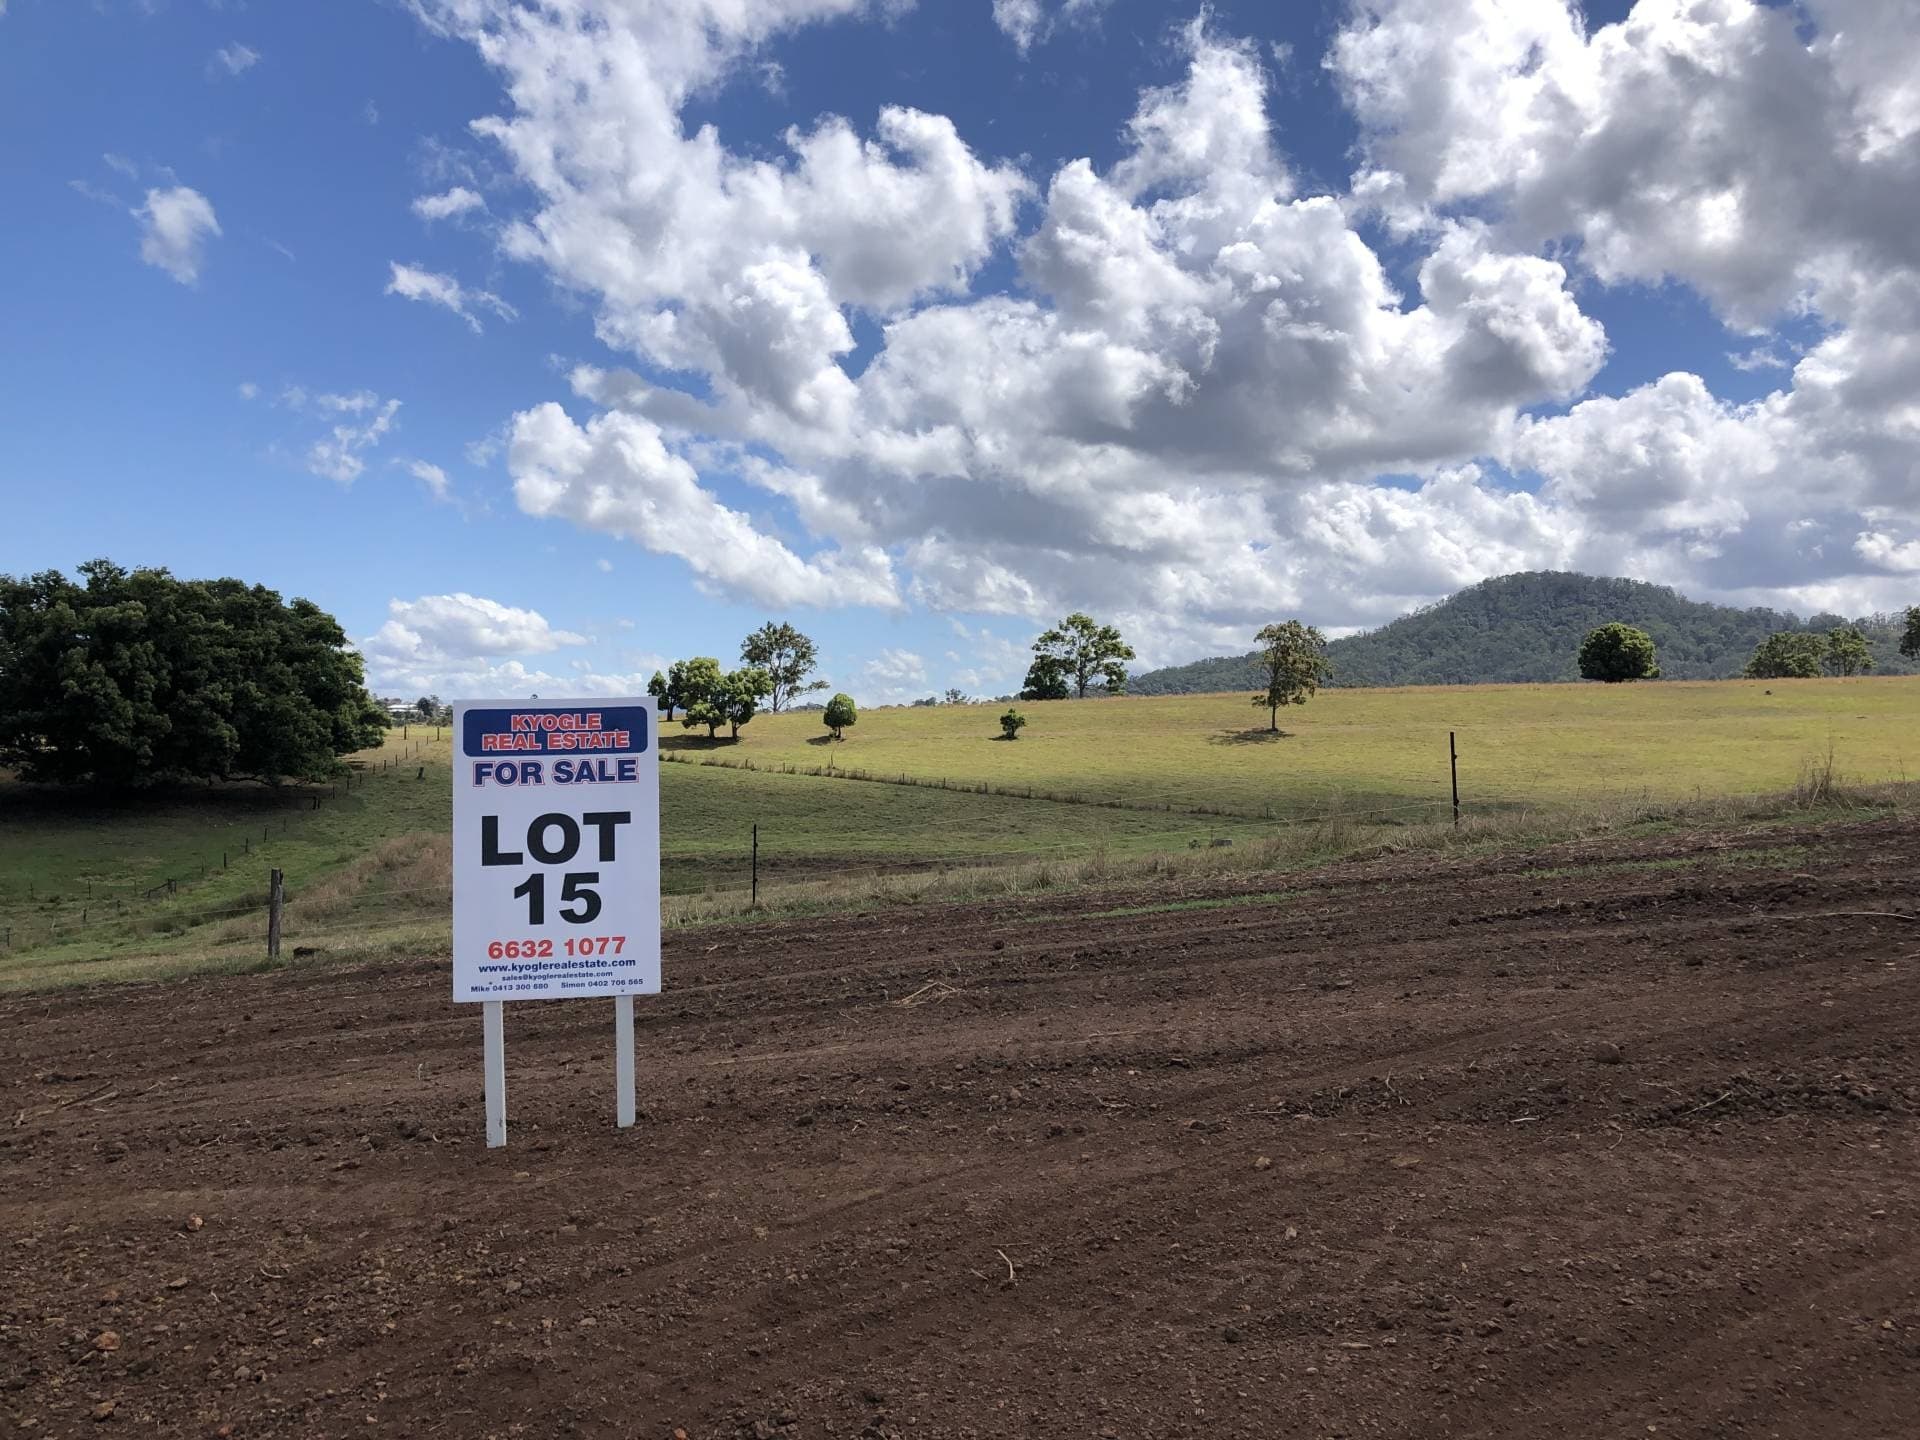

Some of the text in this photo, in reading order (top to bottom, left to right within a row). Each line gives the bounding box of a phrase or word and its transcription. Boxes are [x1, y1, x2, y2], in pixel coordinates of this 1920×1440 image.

[511, 713, 602, 732] KYOGLE
[482, 731, 630, 751] REAL ESTATE
[473, 757, 639, 787] FOR SALE
[481, 811, 631, 867] LOT
[513, 872, 602, 925] 15
[488, 936, 626, 960] 6632 1077
[478, 958, 636, 973] www.kyoglerealestate.com
[501, 971, 613, 982] sales@kyoglerealestate.com
[561, 981, 586, 989] Simon
[587, 980, 609, 988] 0402
[470, 985, 490, 993] Mike
